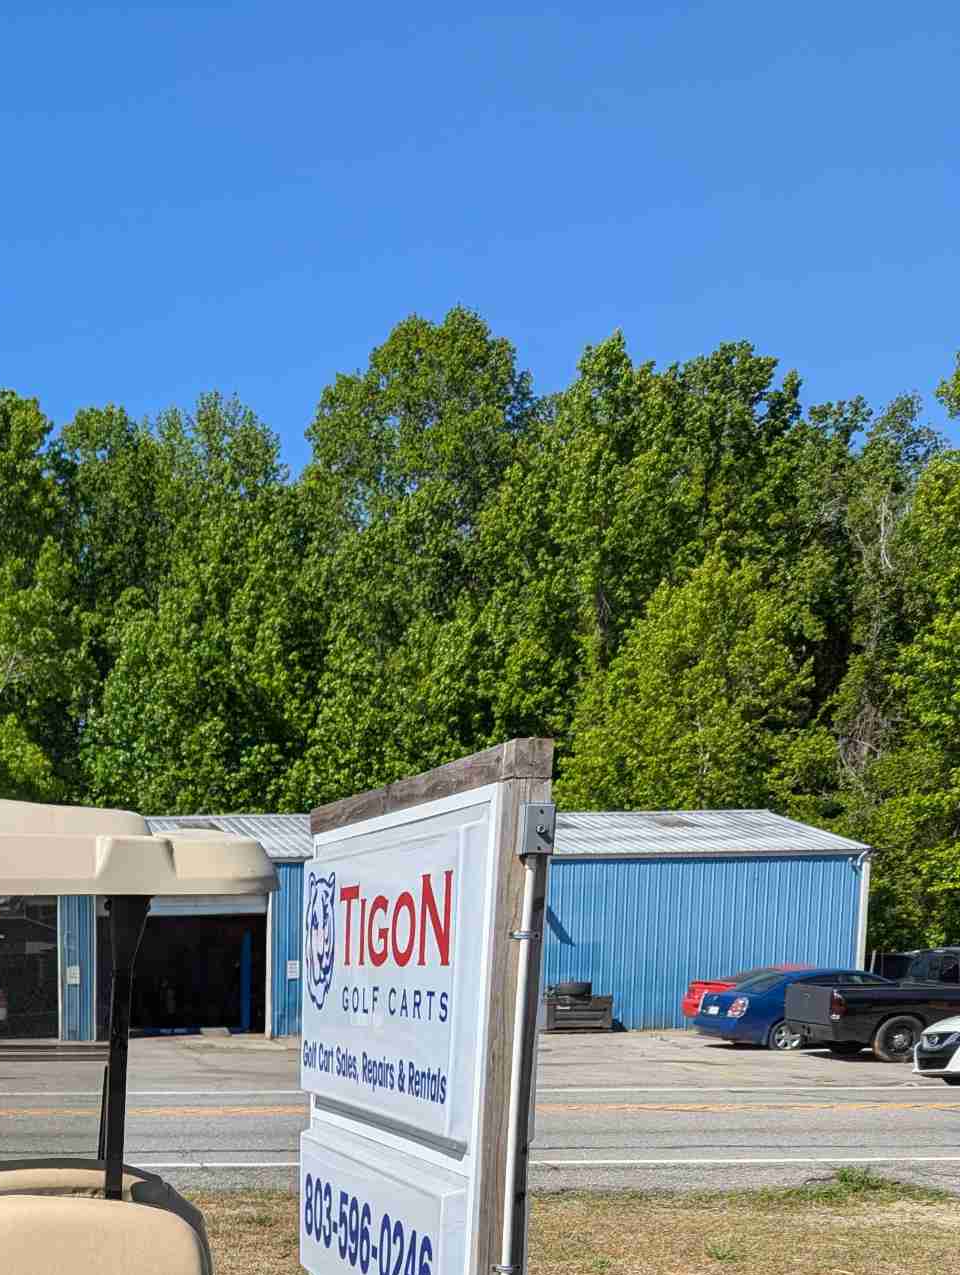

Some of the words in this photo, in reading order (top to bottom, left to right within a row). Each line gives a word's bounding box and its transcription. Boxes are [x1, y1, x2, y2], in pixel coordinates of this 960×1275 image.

[342, 986, 379, 1015] GOLF
[388, 987, 449, 1022] CARTS
[303, 1039, 317, 1068] Golf
[318, 1043, 334, 1075] Cart
[336, 1045, 359, 1084] Sales,
[362, 1052, 395, 1091] Repairs
[398, 1060, 406, 1093] &
[408, 1062, 447, 1104] Rentals
